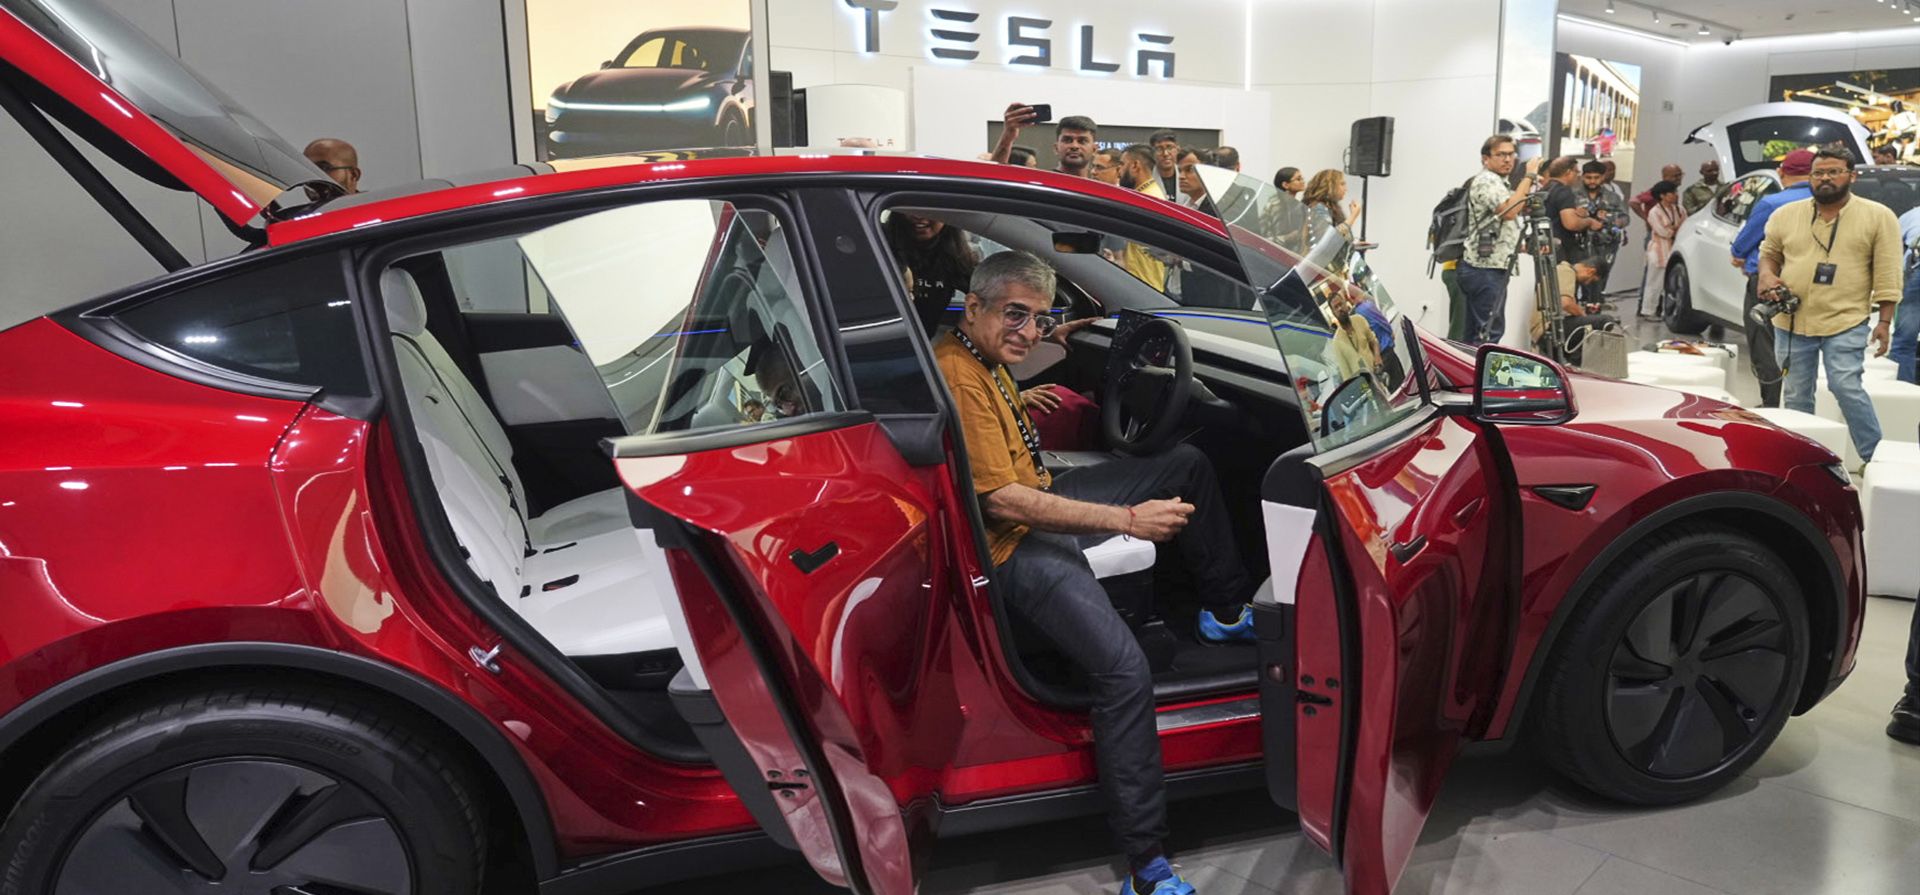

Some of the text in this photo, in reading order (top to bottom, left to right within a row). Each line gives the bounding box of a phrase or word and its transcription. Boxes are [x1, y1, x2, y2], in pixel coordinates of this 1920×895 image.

[844, 0, 1176, 78] TESLA
[836, 137, 894, 147] TLA
[1017, 420, 1036, 456] TESLA
